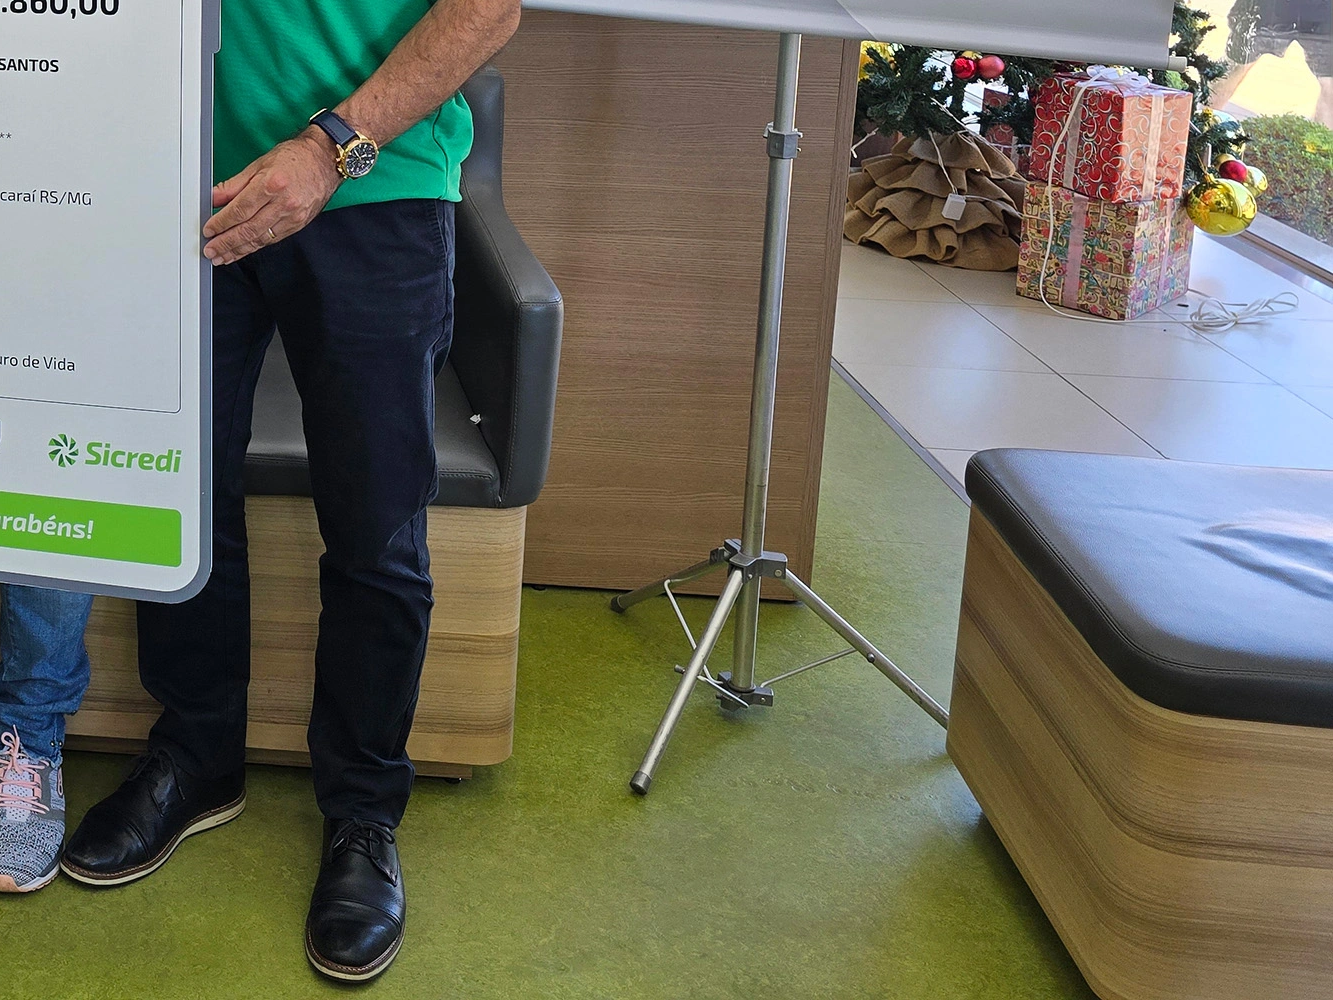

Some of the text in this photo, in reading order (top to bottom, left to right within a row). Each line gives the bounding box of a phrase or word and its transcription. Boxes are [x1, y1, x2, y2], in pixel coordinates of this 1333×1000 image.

[40, 190, 92, 206] RS/MG
[22, 355, 40, 368] de
[43, 356, 76, 371] Vida
[84, 441, 182, 473] Sicredi
